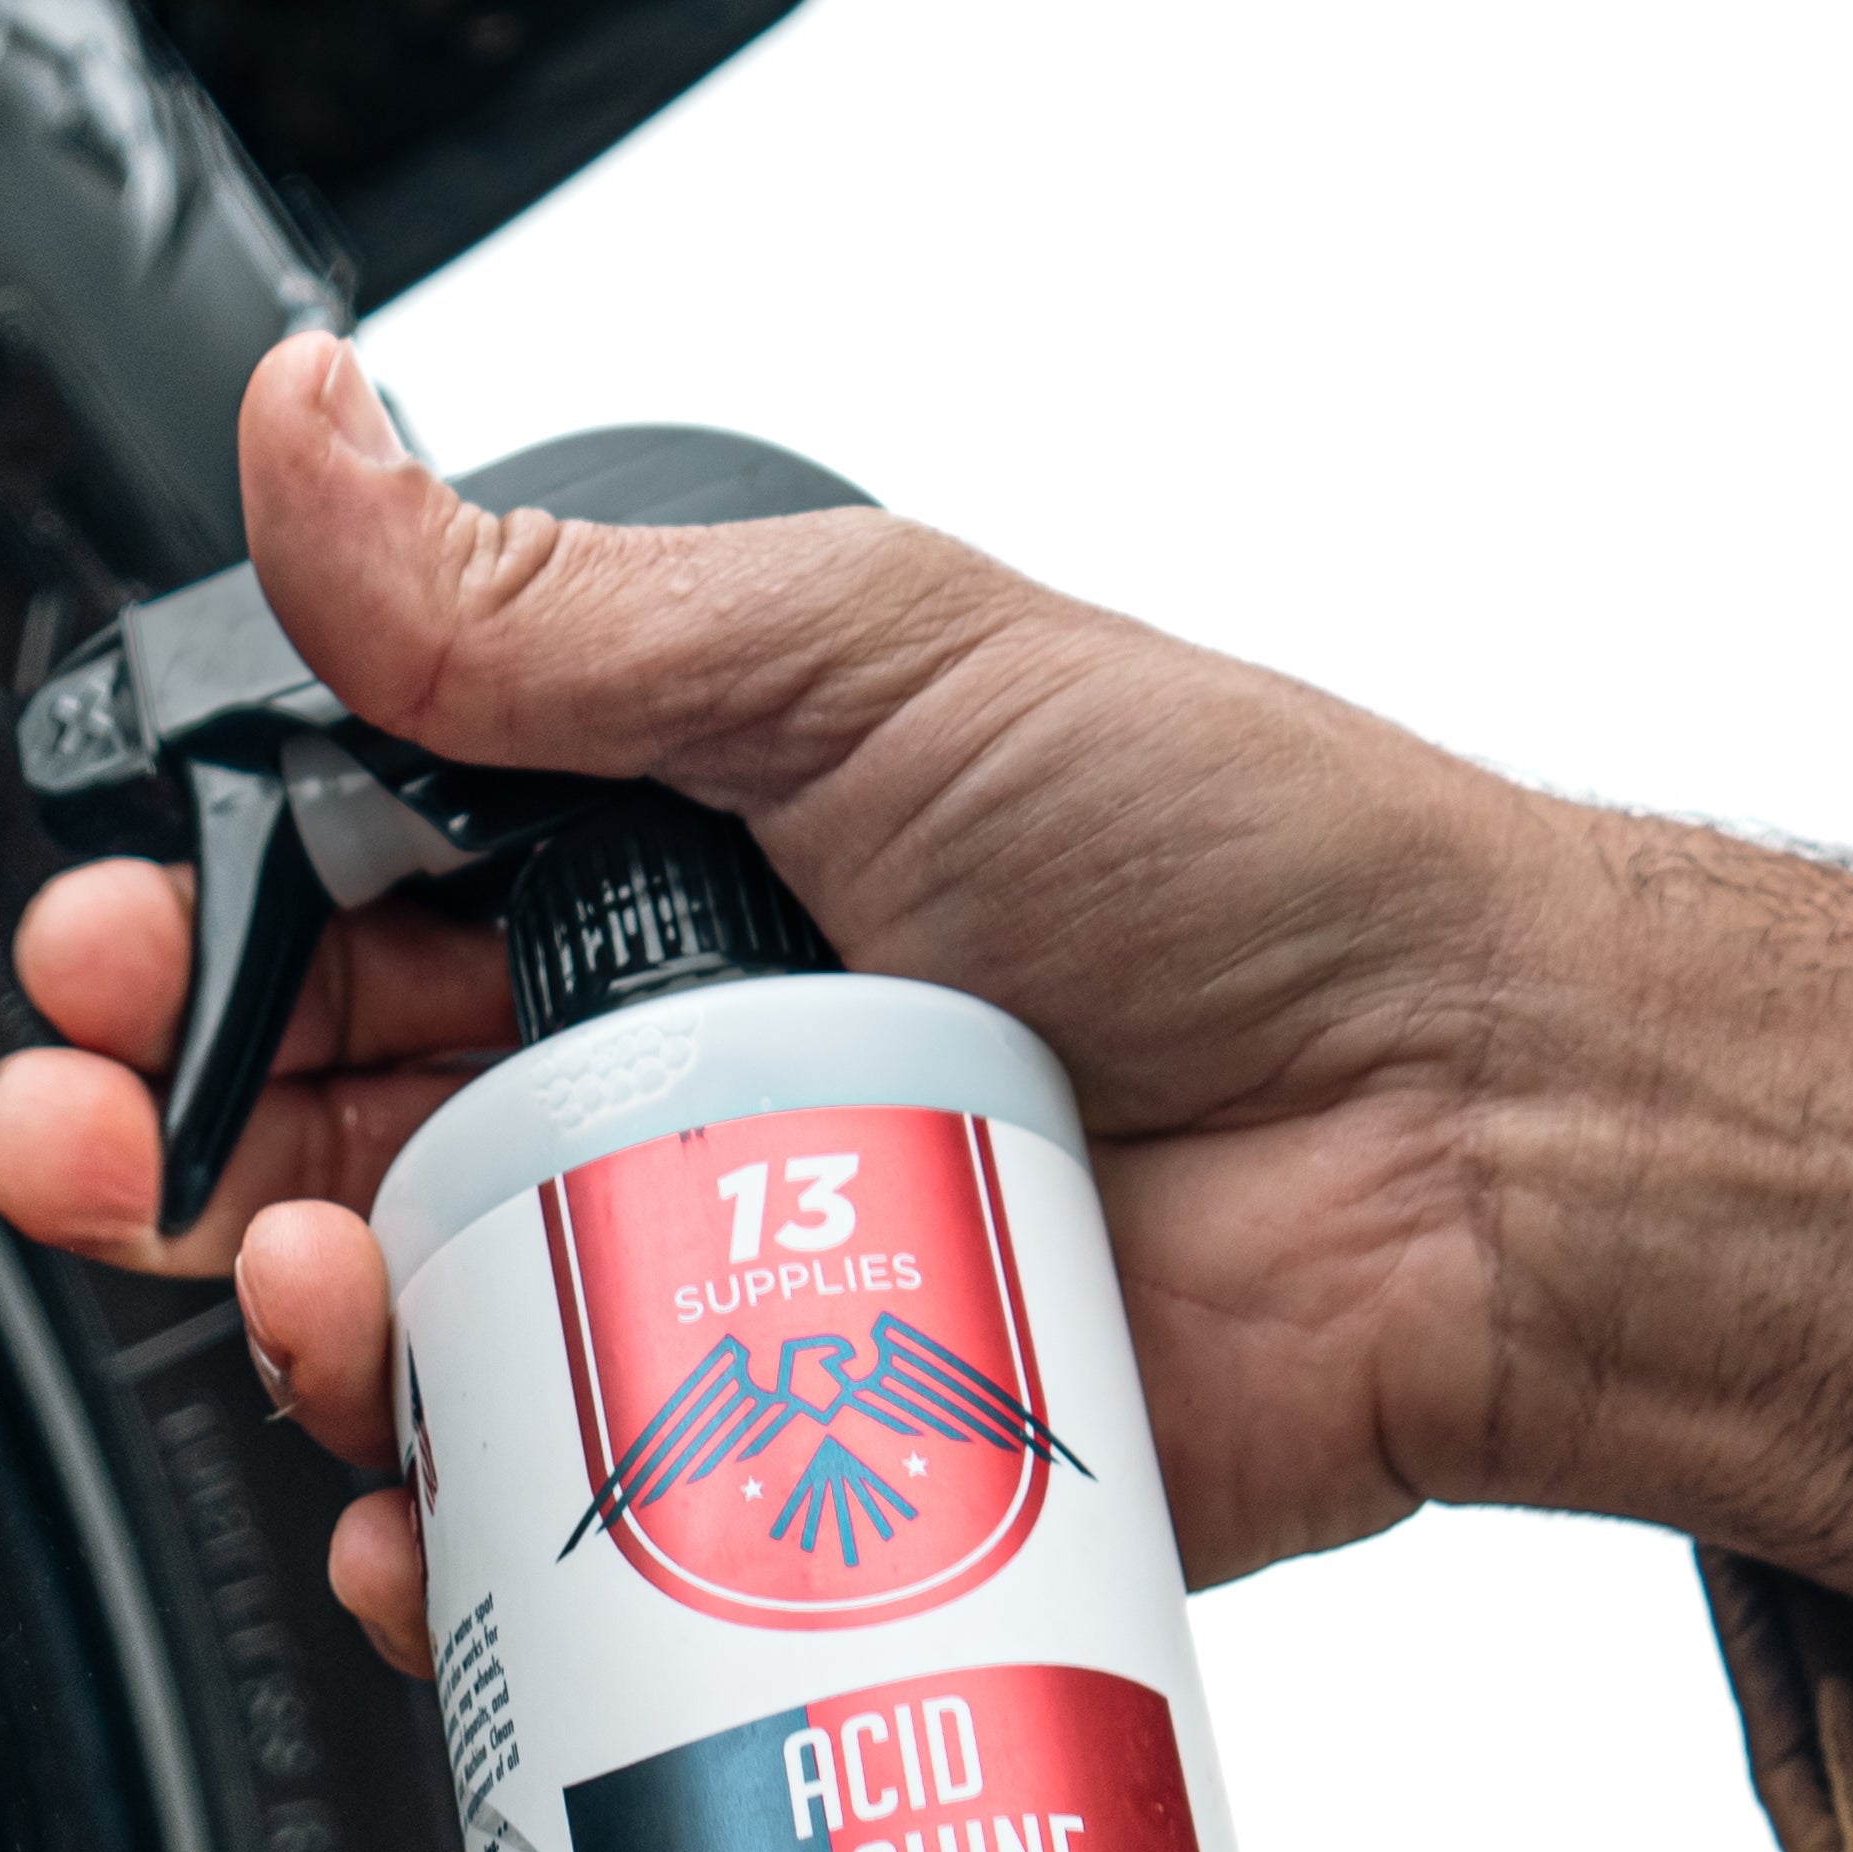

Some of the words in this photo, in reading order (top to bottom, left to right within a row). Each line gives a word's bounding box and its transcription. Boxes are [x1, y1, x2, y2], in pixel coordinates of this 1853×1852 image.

[716, 1152, 860, 1265] 13
[673, 1252, 923, 1324] SUPPLIES
[474, 1591, 494, 1625] spot
[462, 1636, 484, 1673] works
[483, 1625, 498, 1650] for
[473, 1652, 505, 1696] wheels,
[491, 1677, 510, 1715] and
[489, 1717, 515, 1751] Clean
[496, 1751, 506, 1783] of
[507, 1740, 520, 1772] all
[781, 1693, 984, 1841] ACID
